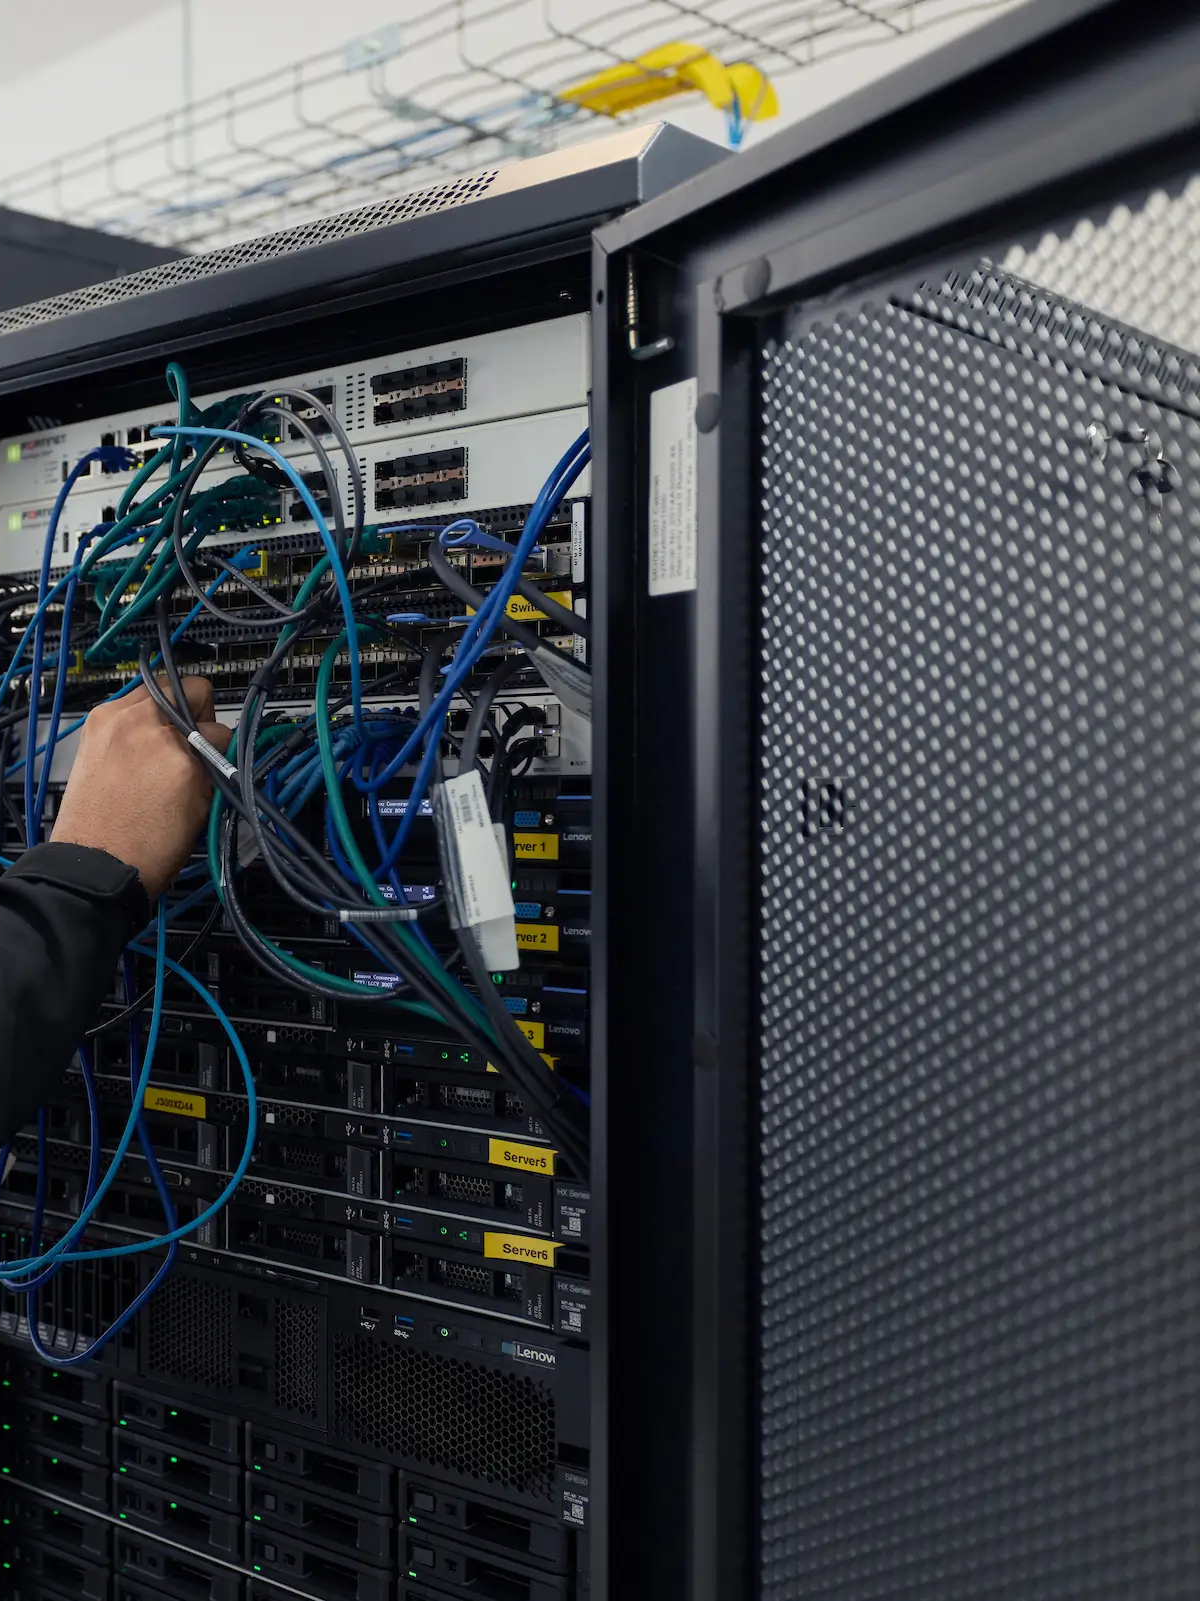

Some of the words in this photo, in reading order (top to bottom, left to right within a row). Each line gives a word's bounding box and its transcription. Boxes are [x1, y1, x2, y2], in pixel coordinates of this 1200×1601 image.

[515, 842, 537, 852] rver
[540, 842, 545, 852] 1
[516, 933, 538, 943] rver
[540, 933, 547, 943] 2
[527, 1030, 534, 1040] 3
[548, 1024, 580, 1035] Lenovo
[503, 1151, 547, 1168] Server5
[557, 1188, 568, 1197] HX
[569, 1190, 590, 1200] Series
[503, 1243, 548, 1260] Server6
[558, 1281, 568, 1291] HX
[569, 1283, 590, 1295] Series
[564, 1473, 588, 1486] SR650
